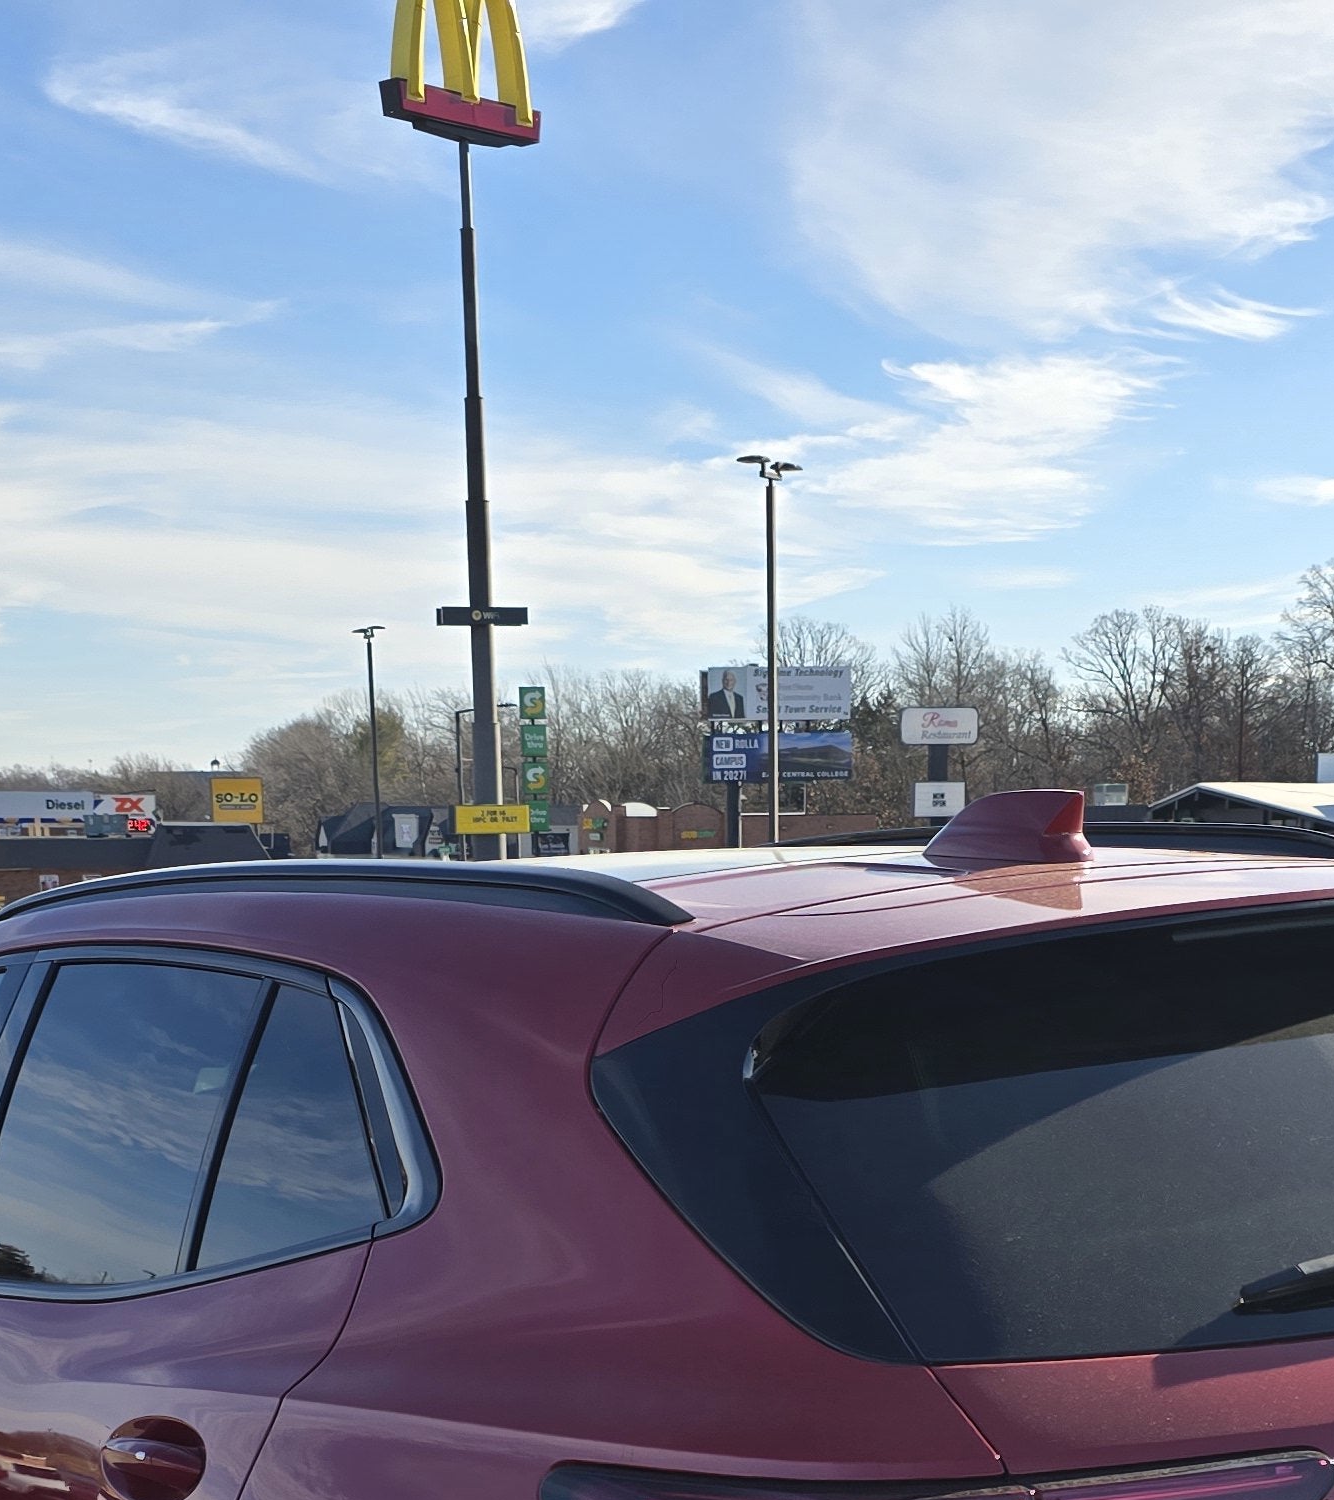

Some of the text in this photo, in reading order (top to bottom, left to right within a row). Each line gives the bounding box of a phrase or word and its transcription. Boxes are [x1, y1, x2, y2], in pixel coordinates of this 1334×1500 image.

[794, 667, 844, 678] Technology
[784, 705, 806, 714] Town
[808, 704, 842, 714] Service
[524, 733, 544, 741] Drive
[921, 730, 971, 740] Restaurant
[527, 741, 544, 749] thru
[715, 739, 759, 749] NEW ROLLA
[715, 756, 745, 767] CAMPUS
[215, 792, 258, 803] SO-LO
[45, 799, 85, 811] Diesel
[111, 797, 145, 813] ZX
